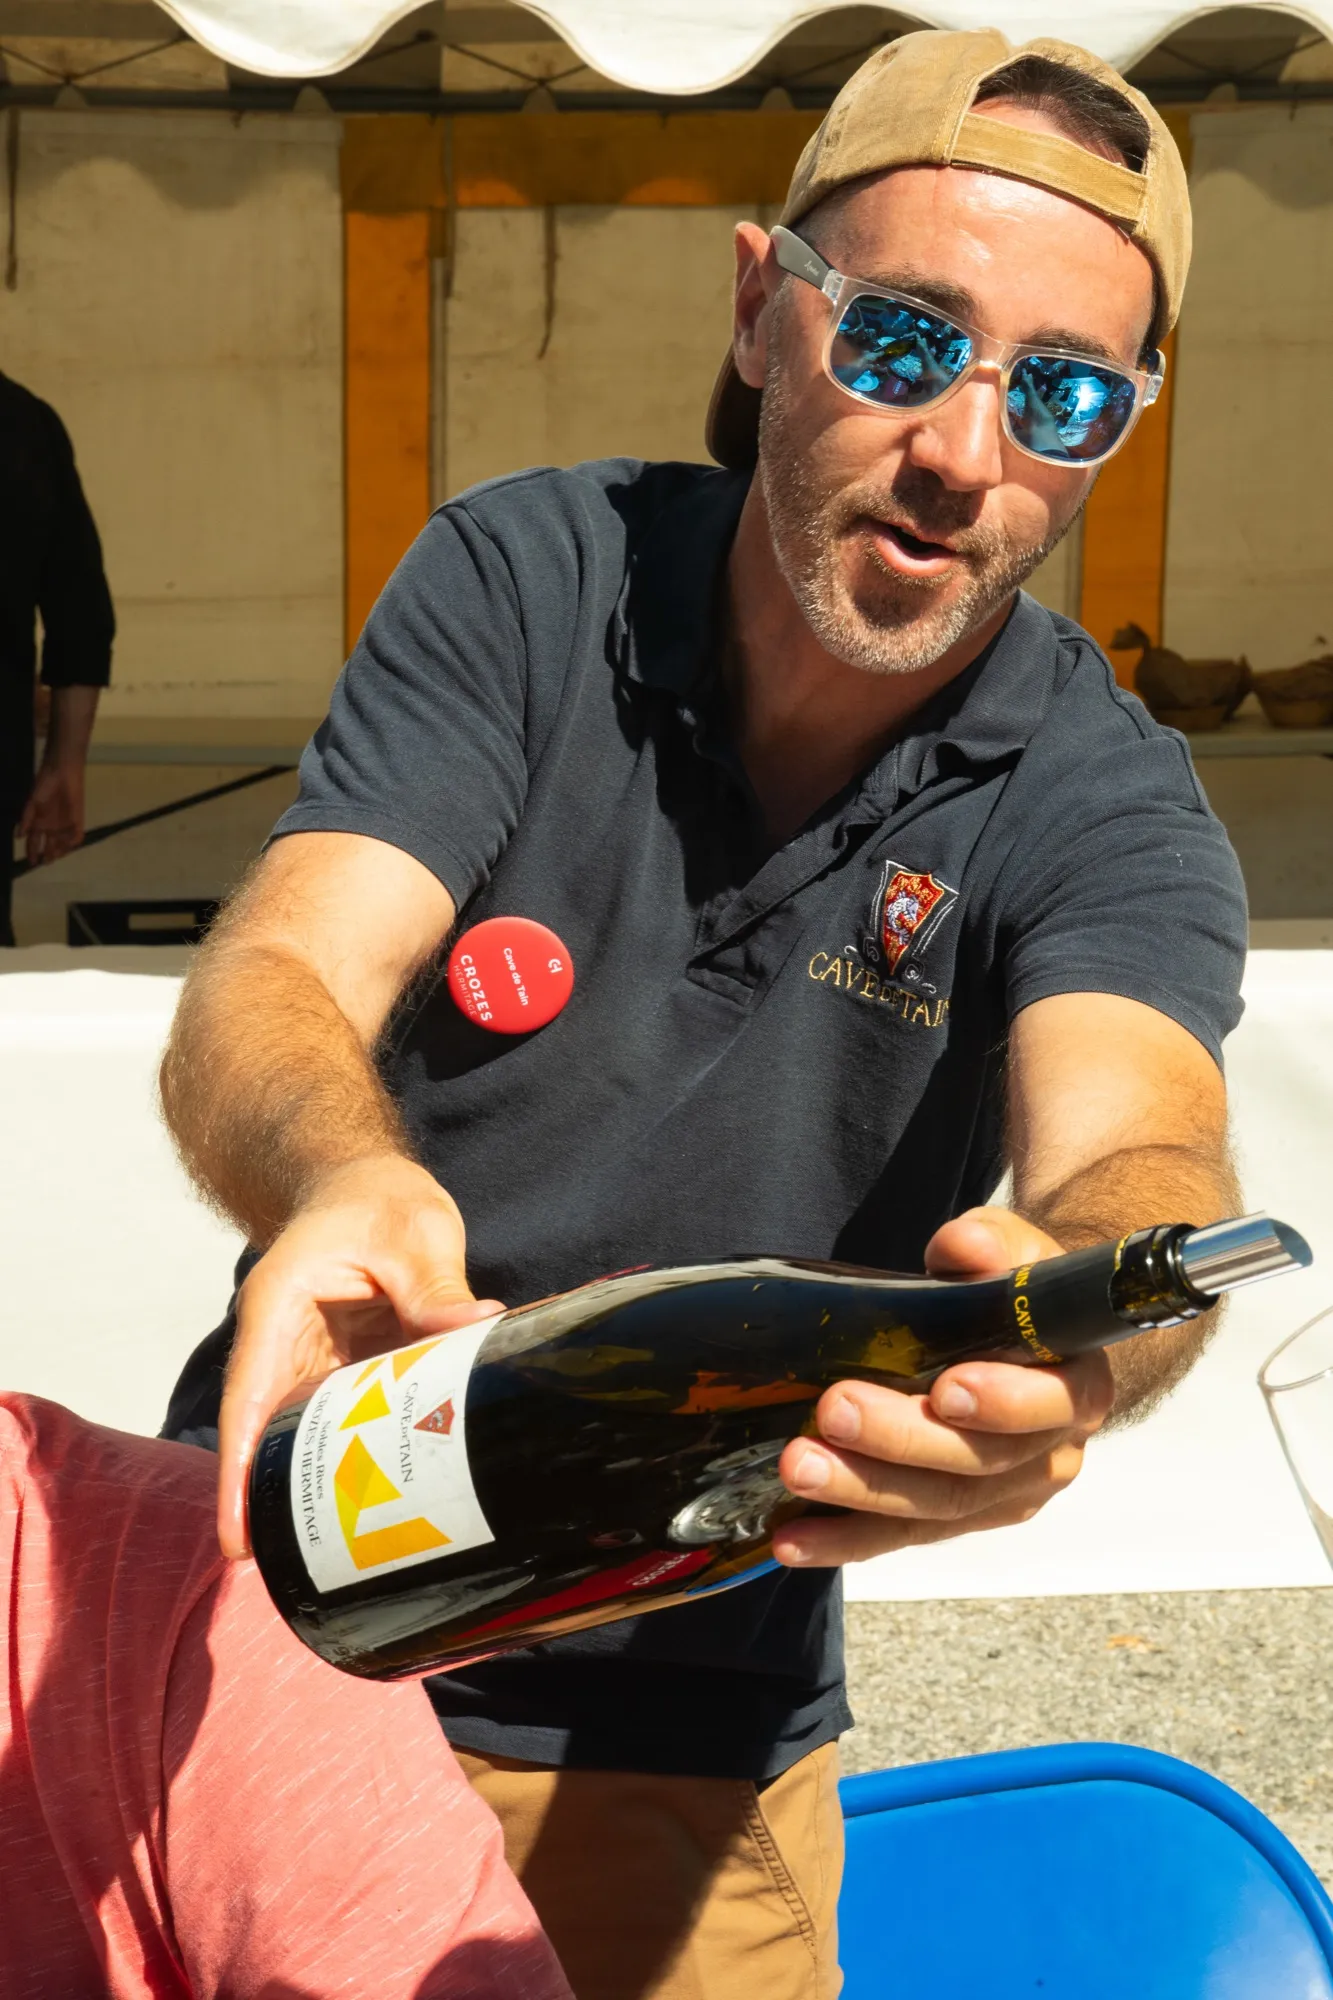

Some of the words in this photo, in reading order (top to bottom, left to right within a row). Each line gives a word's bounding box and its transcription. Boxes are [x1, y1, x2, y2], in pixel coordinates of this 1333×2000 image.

[503, 947, 516, 971] Cave
[511, 971, 522, 985] de
[808, 951, 880, 999] CAVE
[453, 964, 478, 1017] HERMITAGE
[460, 954, 493, 1022] CROZES
[516, 985, 529, 1006] Tain
[1014, 1295, 1037, 1340] CAVE
[400, 1381, 419, 1426] CAVE
[316, 1420, 332, 1462] Nobles
[400, 1440, 414, 1483] TAIN
[315, 1464, 325, 1500] Rives
